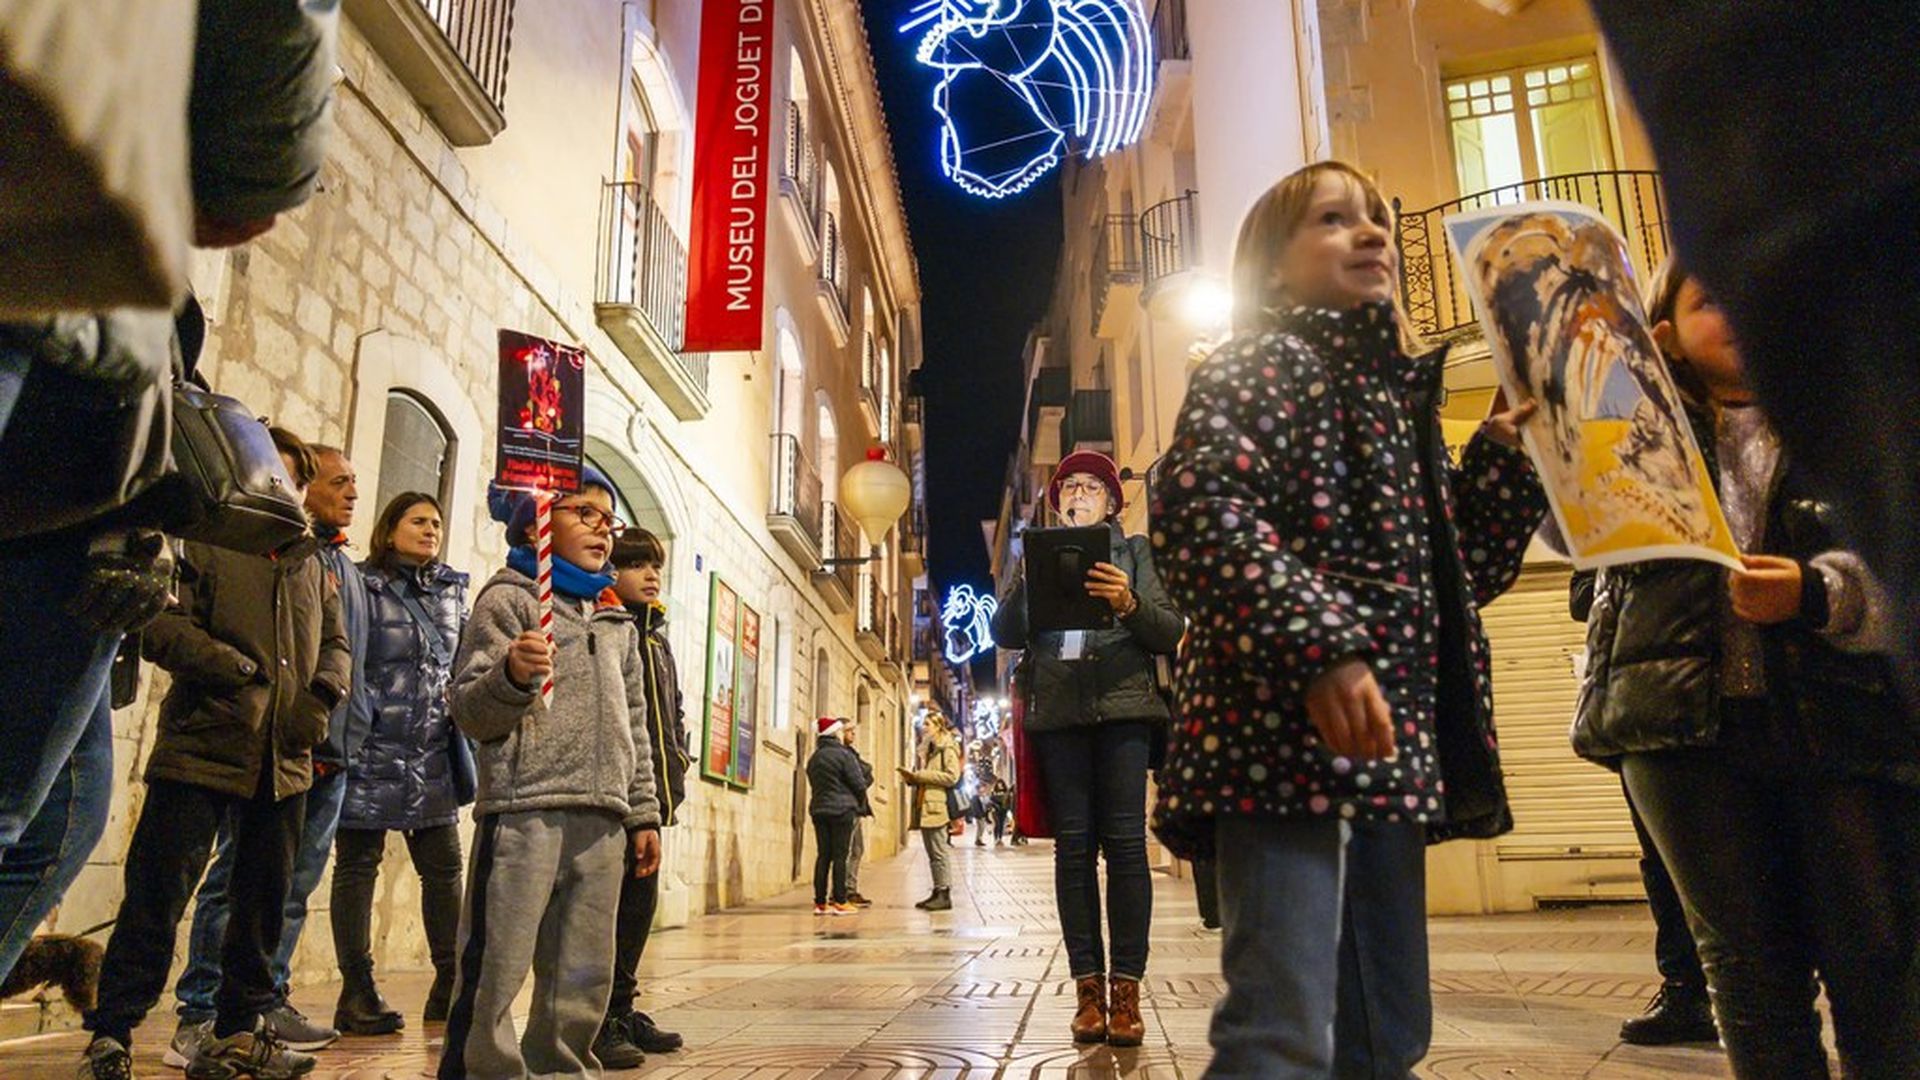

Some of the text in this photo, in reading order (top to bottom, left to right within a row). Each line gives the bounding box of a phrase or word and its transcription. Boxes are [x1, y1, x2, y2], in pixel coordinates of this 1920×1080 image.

[735, 31, 761, 136] JOGUET
[732, 146, 757, 199] DEL
[727, 207, 756, 310] MUSEU
